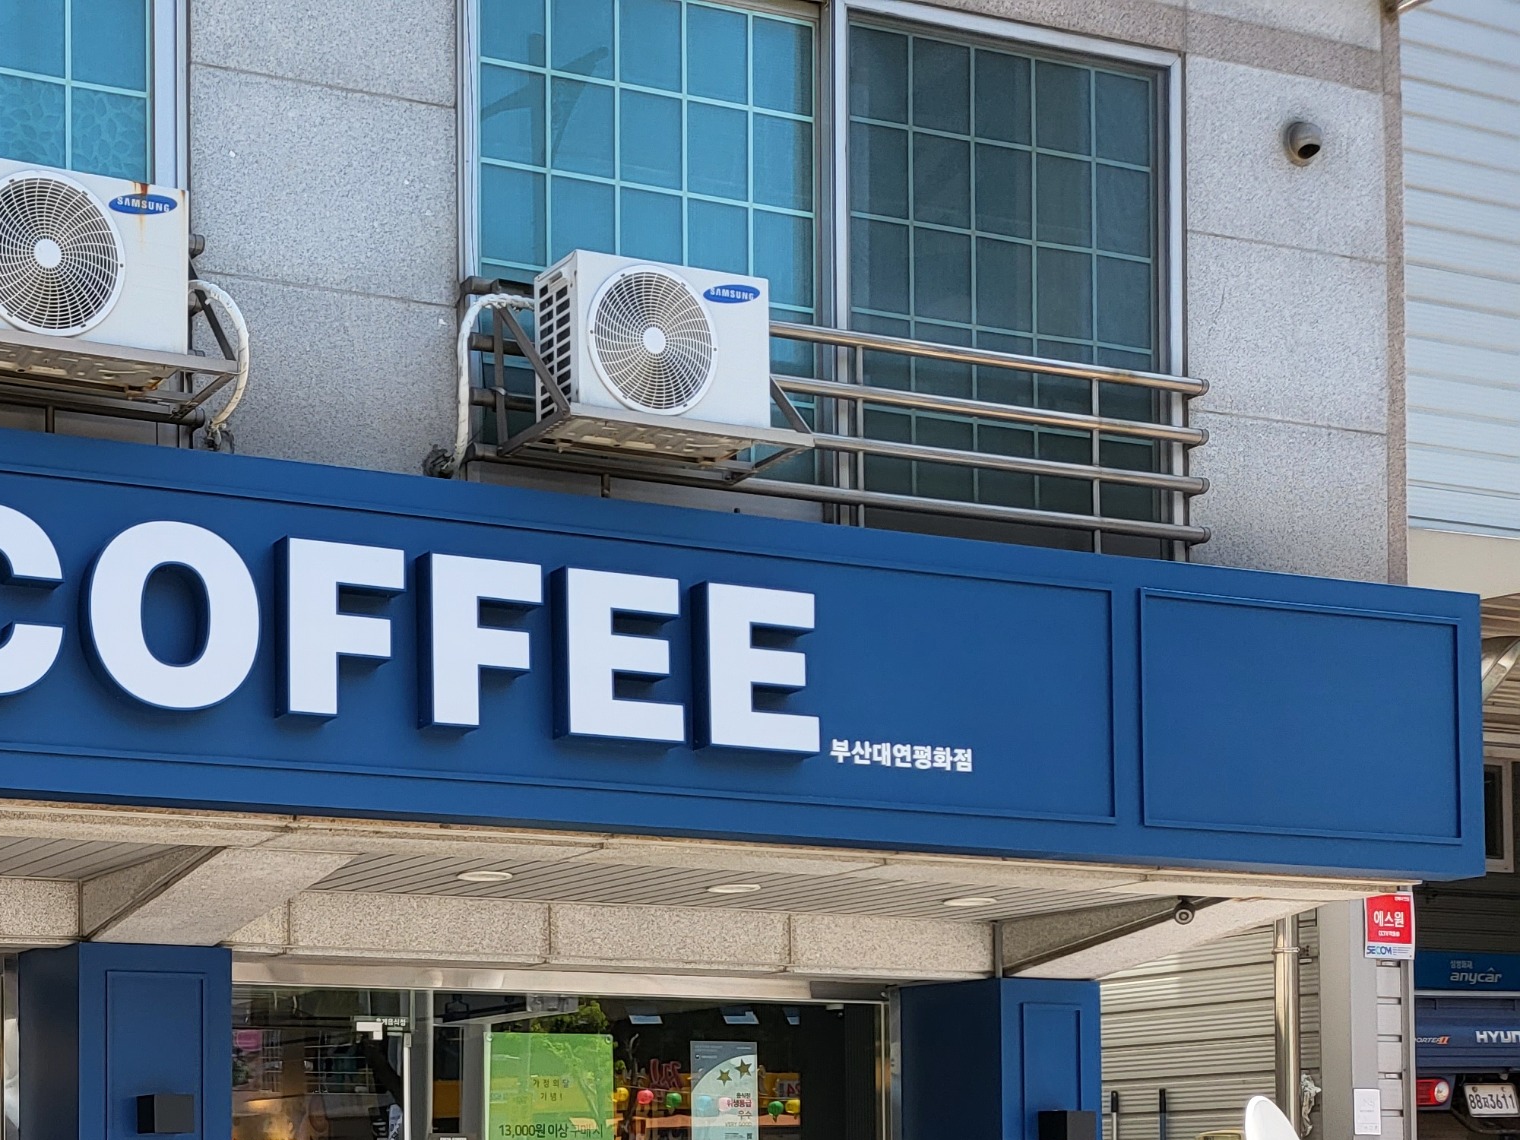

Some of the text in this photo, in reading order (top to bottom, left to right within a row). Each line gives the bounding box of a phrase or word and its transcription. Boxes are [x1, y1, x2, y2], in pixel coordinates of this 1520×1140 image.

[117, 196, 170, 212] SAMSUNG
[709, 287, 754, 301] SAMSUNG
[830, 738, 973, 773] 부산대연평화점
[1373, 910, 1405, 928] 에스원
[1366, 945, 1392, 955] SECOM
[1450, 969, 1502, 984] anycar
[498, 1123, 546, 1139] 13,000원
[548, 1123, 568, 1139] 이상
